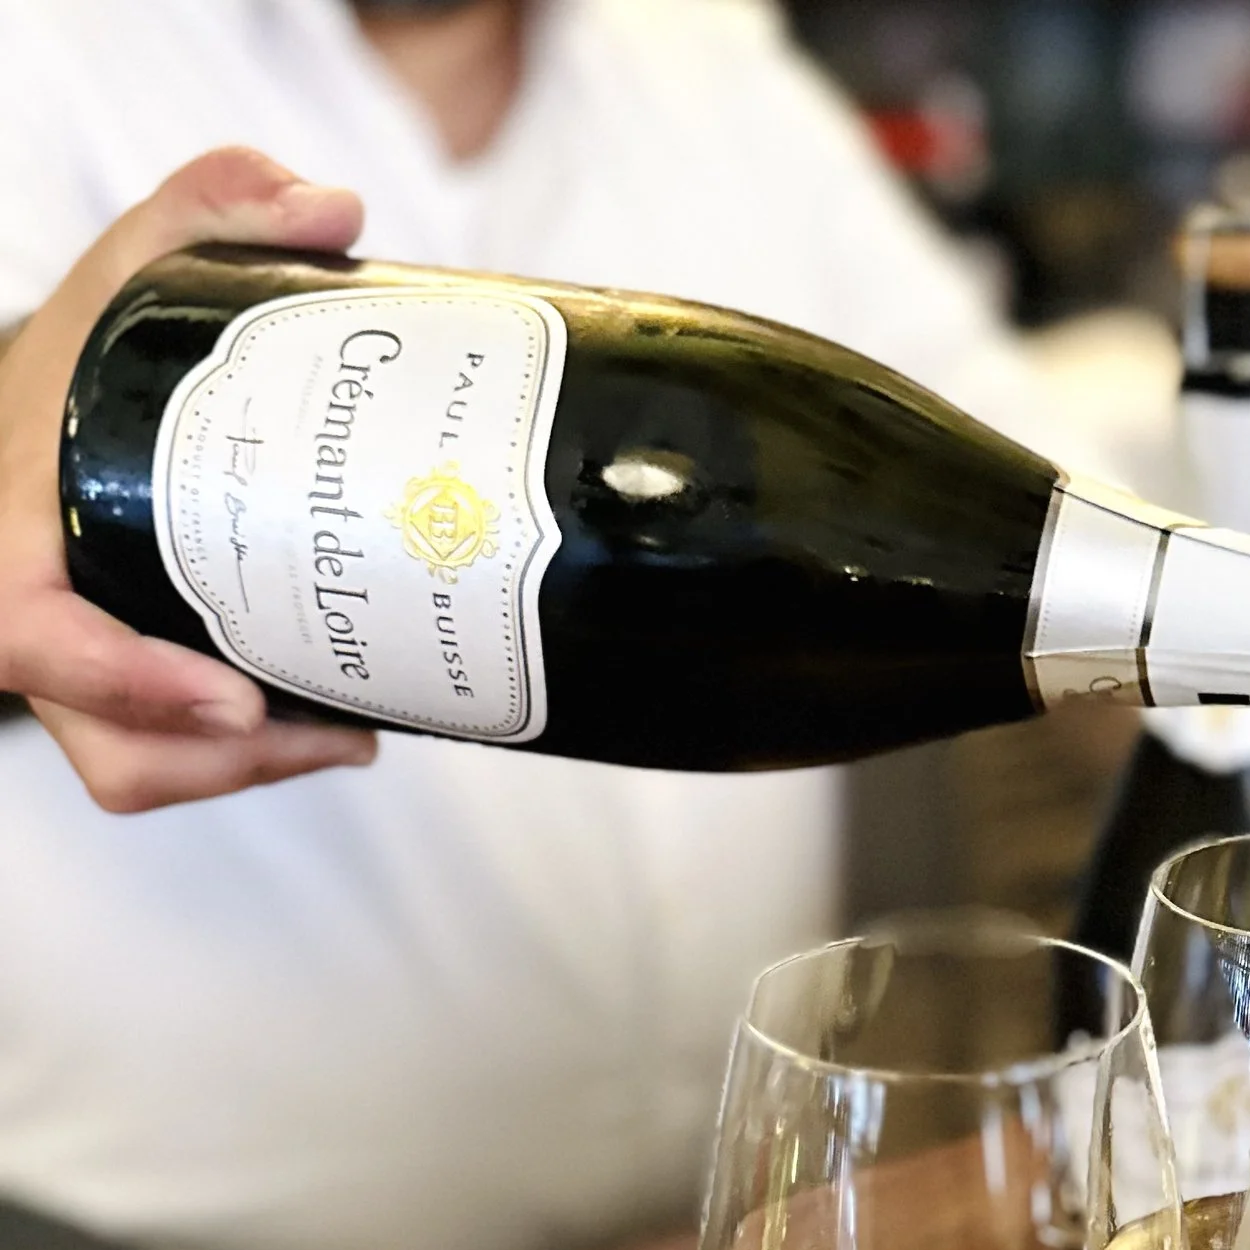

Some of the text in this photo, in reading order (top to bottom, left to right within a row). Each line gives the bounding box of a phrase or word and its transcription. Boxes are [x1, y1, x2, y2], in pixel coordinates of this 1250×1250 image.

[308, 329, 402, 522] Crémant
[312, 529, 365, 578] de
[432, 352, 486, 699] PAUL BUISSE
[313, 581, 370, 681] Loire
